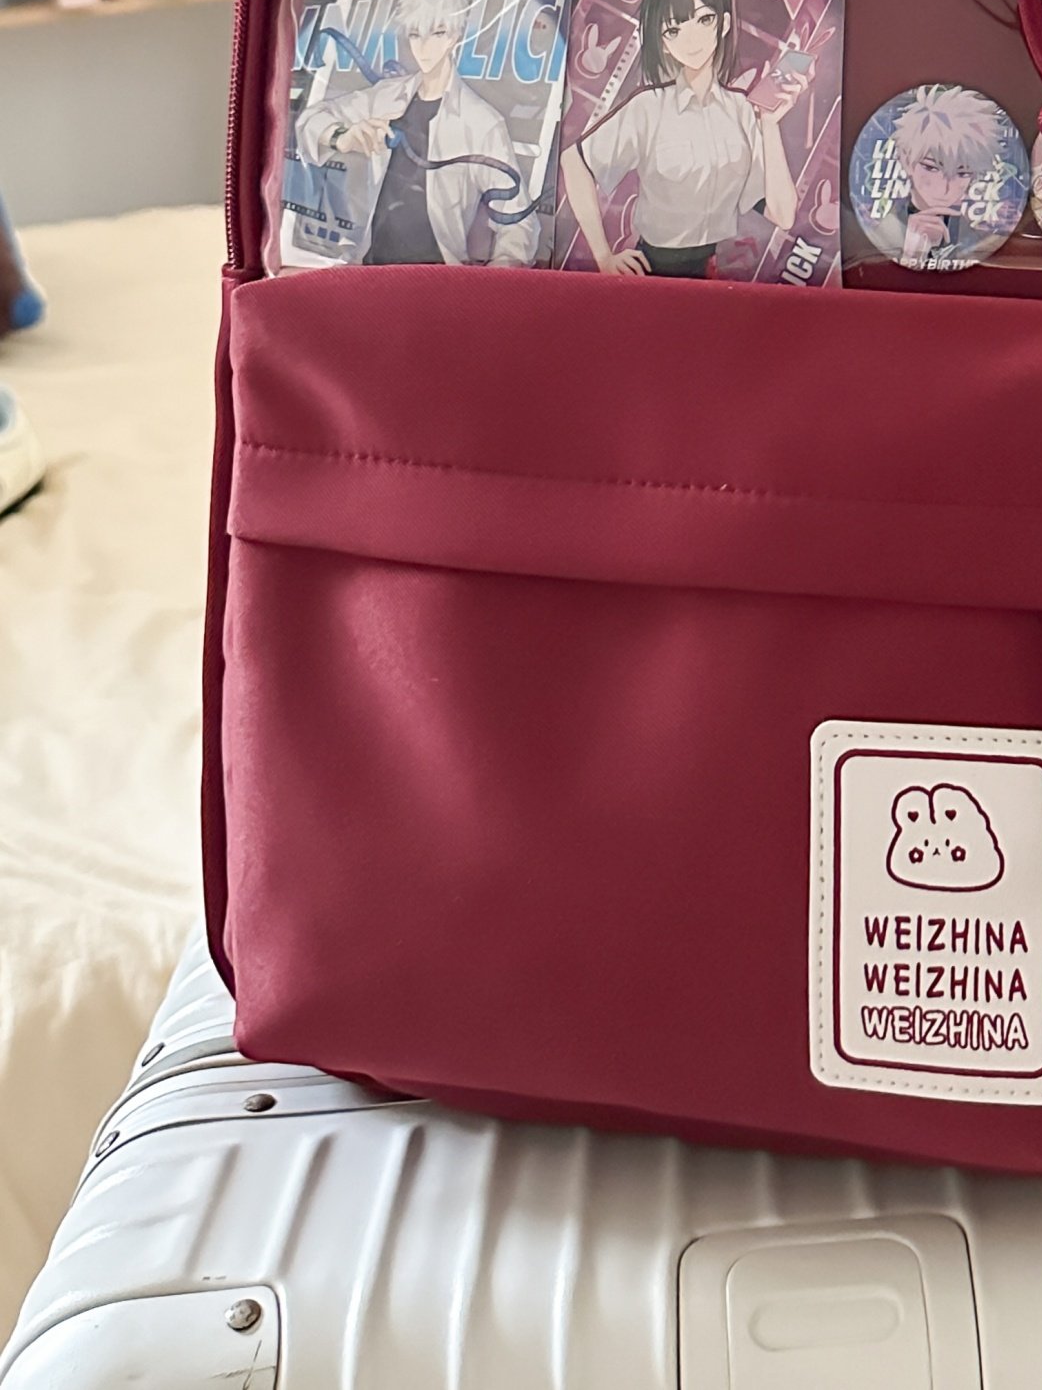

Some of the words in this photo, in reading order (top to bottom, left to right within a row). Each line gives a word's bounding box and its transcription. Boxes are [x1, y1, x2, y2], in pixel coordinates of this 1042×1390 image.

[864, 915, 1028, 955] WEIZHINA
[864, 963, 1028, 1003] WEIZHINA
[861, 1006, 1029, 1051] WEIZHINA
